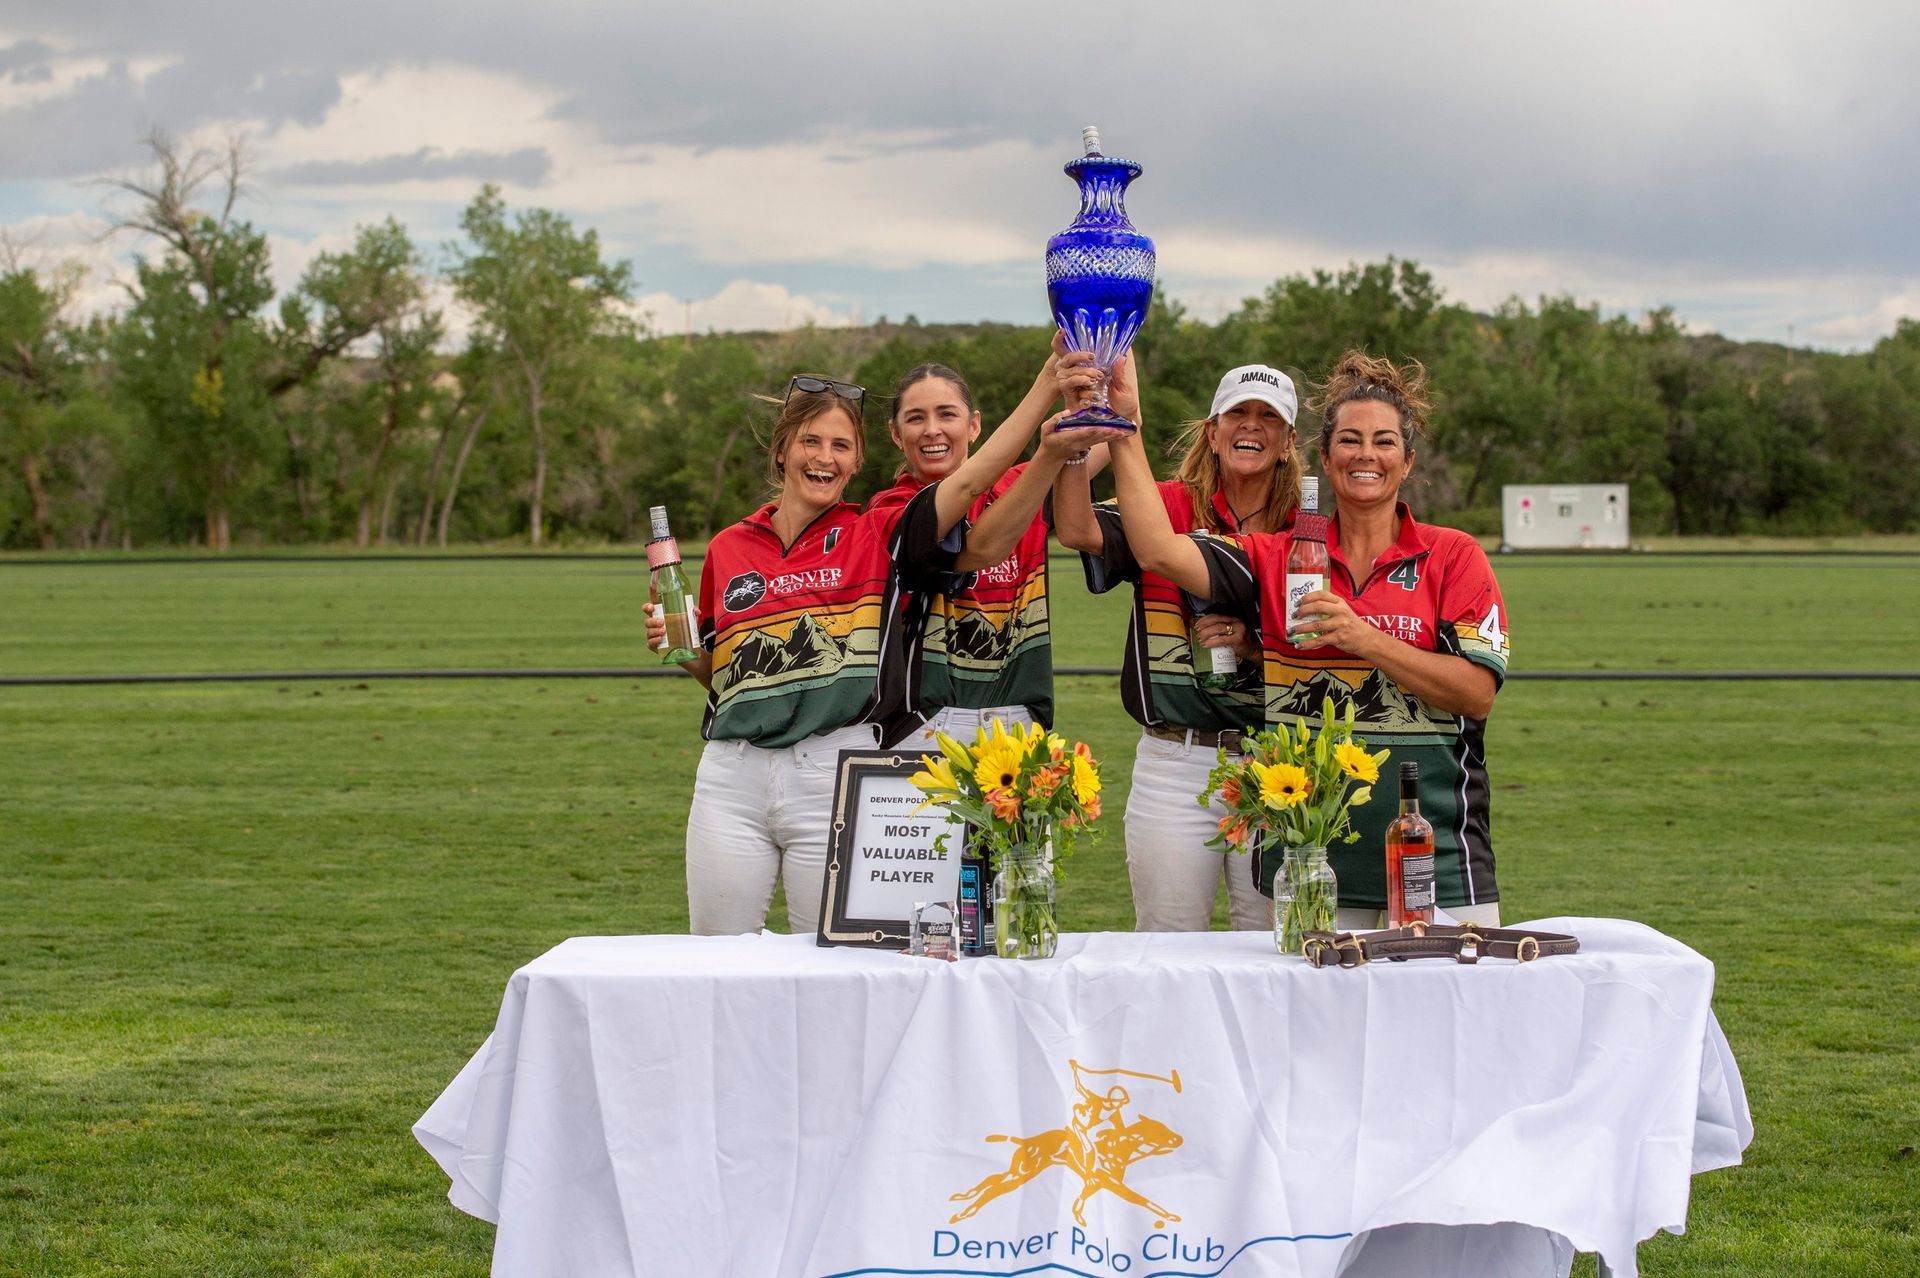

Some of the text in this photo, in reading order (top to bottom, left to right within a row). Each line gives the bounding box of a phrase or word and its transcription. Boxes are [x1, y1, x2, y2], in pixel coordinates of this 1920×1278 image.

[1238, 371, 1279, 388] JAMAICA
[768, 568, 842, 589] DENVER
[1387, 558, 1420, 591] 4
[773, 582, 803, 595] POLO
[1359, 614, 1423, 633] NVER
[1477, 601, 1505, 653] 4
[870, 796, 903, 804] DENVER
[884, 825, 931, 837] MOST
[862, 847, 948, 861] VALUABLE
[870, 870, 934, 883] PLAYER
[933, 1226, 1225, 1272] Denver Polo Club
